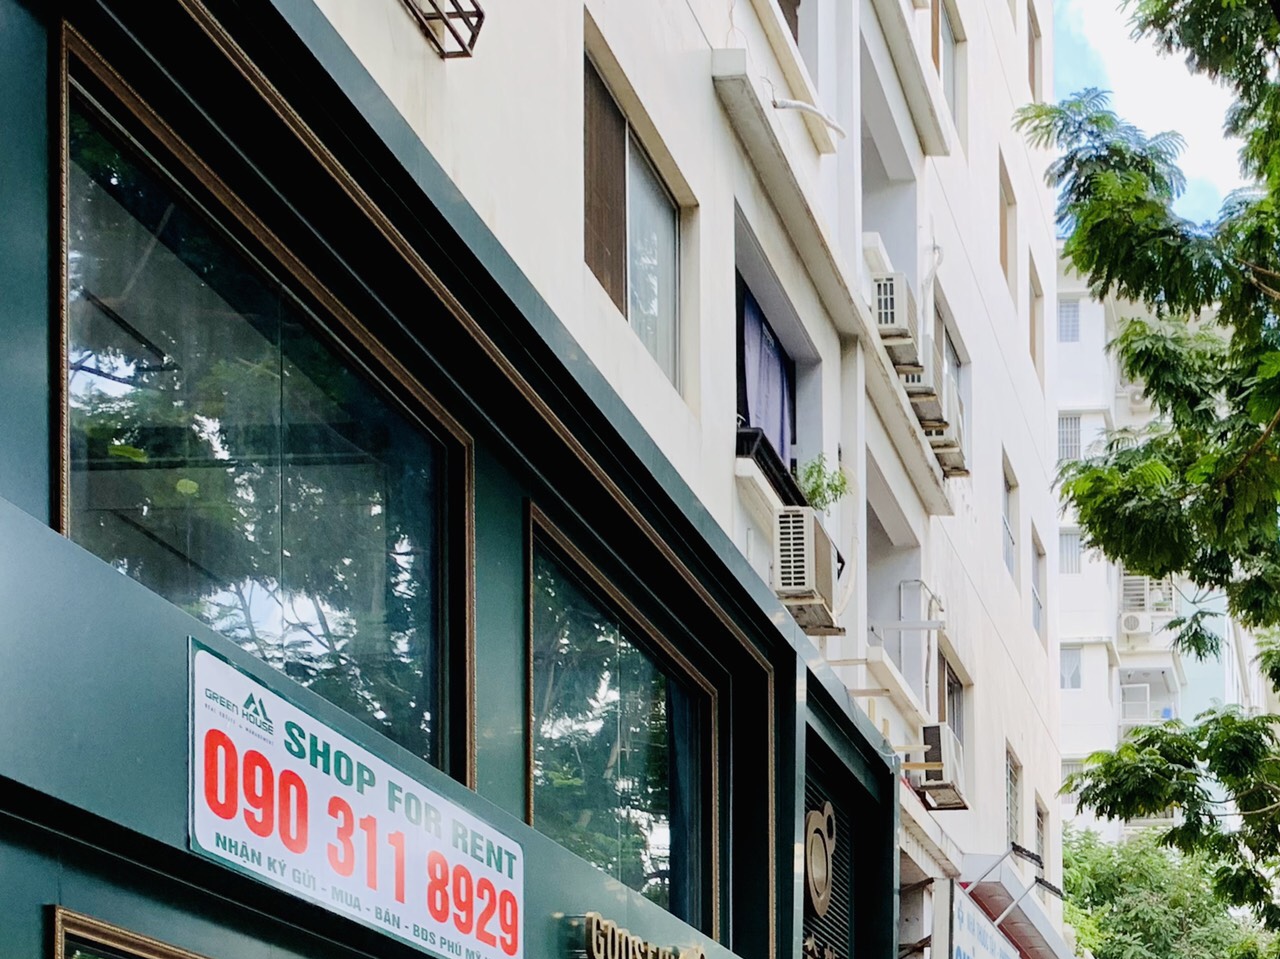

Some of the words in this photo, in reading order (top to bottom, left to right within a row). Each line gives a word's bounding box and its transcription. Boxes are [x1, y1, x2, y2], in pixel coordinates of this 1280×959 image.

[204, 687, 239, 716] GREEN
[242, 709, 274, 736] HOUSE
[203, 728, 308, 854] 090
[326, 795, 405, 904] 311
[427, 850, 519, 956] 8929
[283, 720, 376, 795] SHOP
[387, 779, 442, 840] FOR
[452, 819, 517, 880] RENT
[215, 832, 263, 866] NHẬN
[267, 857, 288, 881] KÝ
[331, 885, 362, 912] MUA
[413, 924, 436, 946] BĐS
